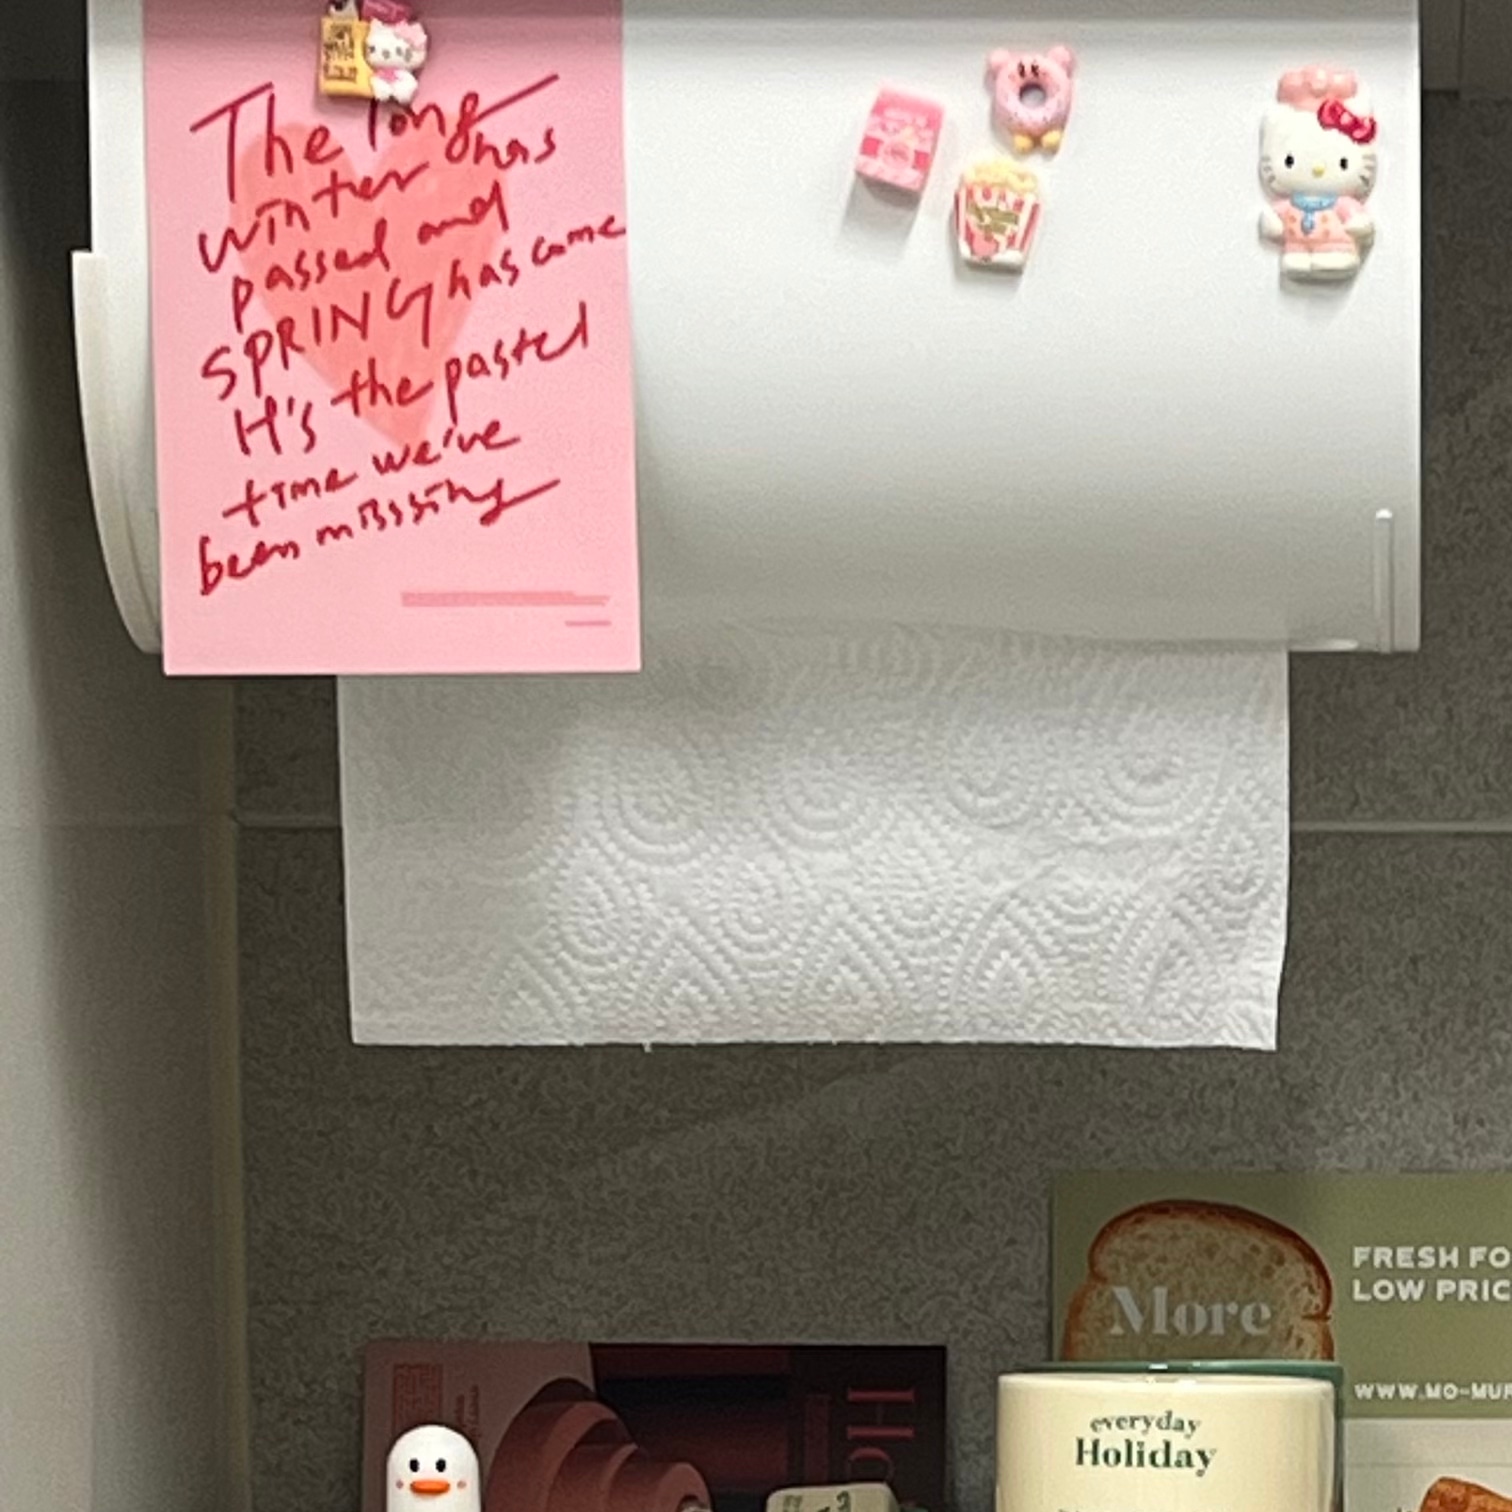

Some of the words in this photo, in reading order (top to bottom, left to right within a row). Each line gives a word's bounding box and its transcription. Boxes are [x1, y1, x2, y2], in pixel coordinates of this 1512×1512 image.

[190, 82, 343, 202] The
[200, 162, 429, 272] winter
[233, 218, 391, 331] passed
[418, 181, 508, 244] and
[201, 279, 433, 399] SPRING
[449, 251, 519, 299] has
[532, 216, 626, 264] come
[331, 357, 434, 415] the
[223, 469, 357, 526] time
[373, 421, 520, 474] we've
[200, 536, 299, 595] been
[317, 479, 560, 545] missing
[1352, 1246, 1459, 1269] FRESH
[1352, 1279, 1425, 1302] LOW
[1108, 1286, 1273, 1337] More
[1075, 1437, 1217, 1477] Holiday
[1090, 1410, 1200, 1439] everyday
